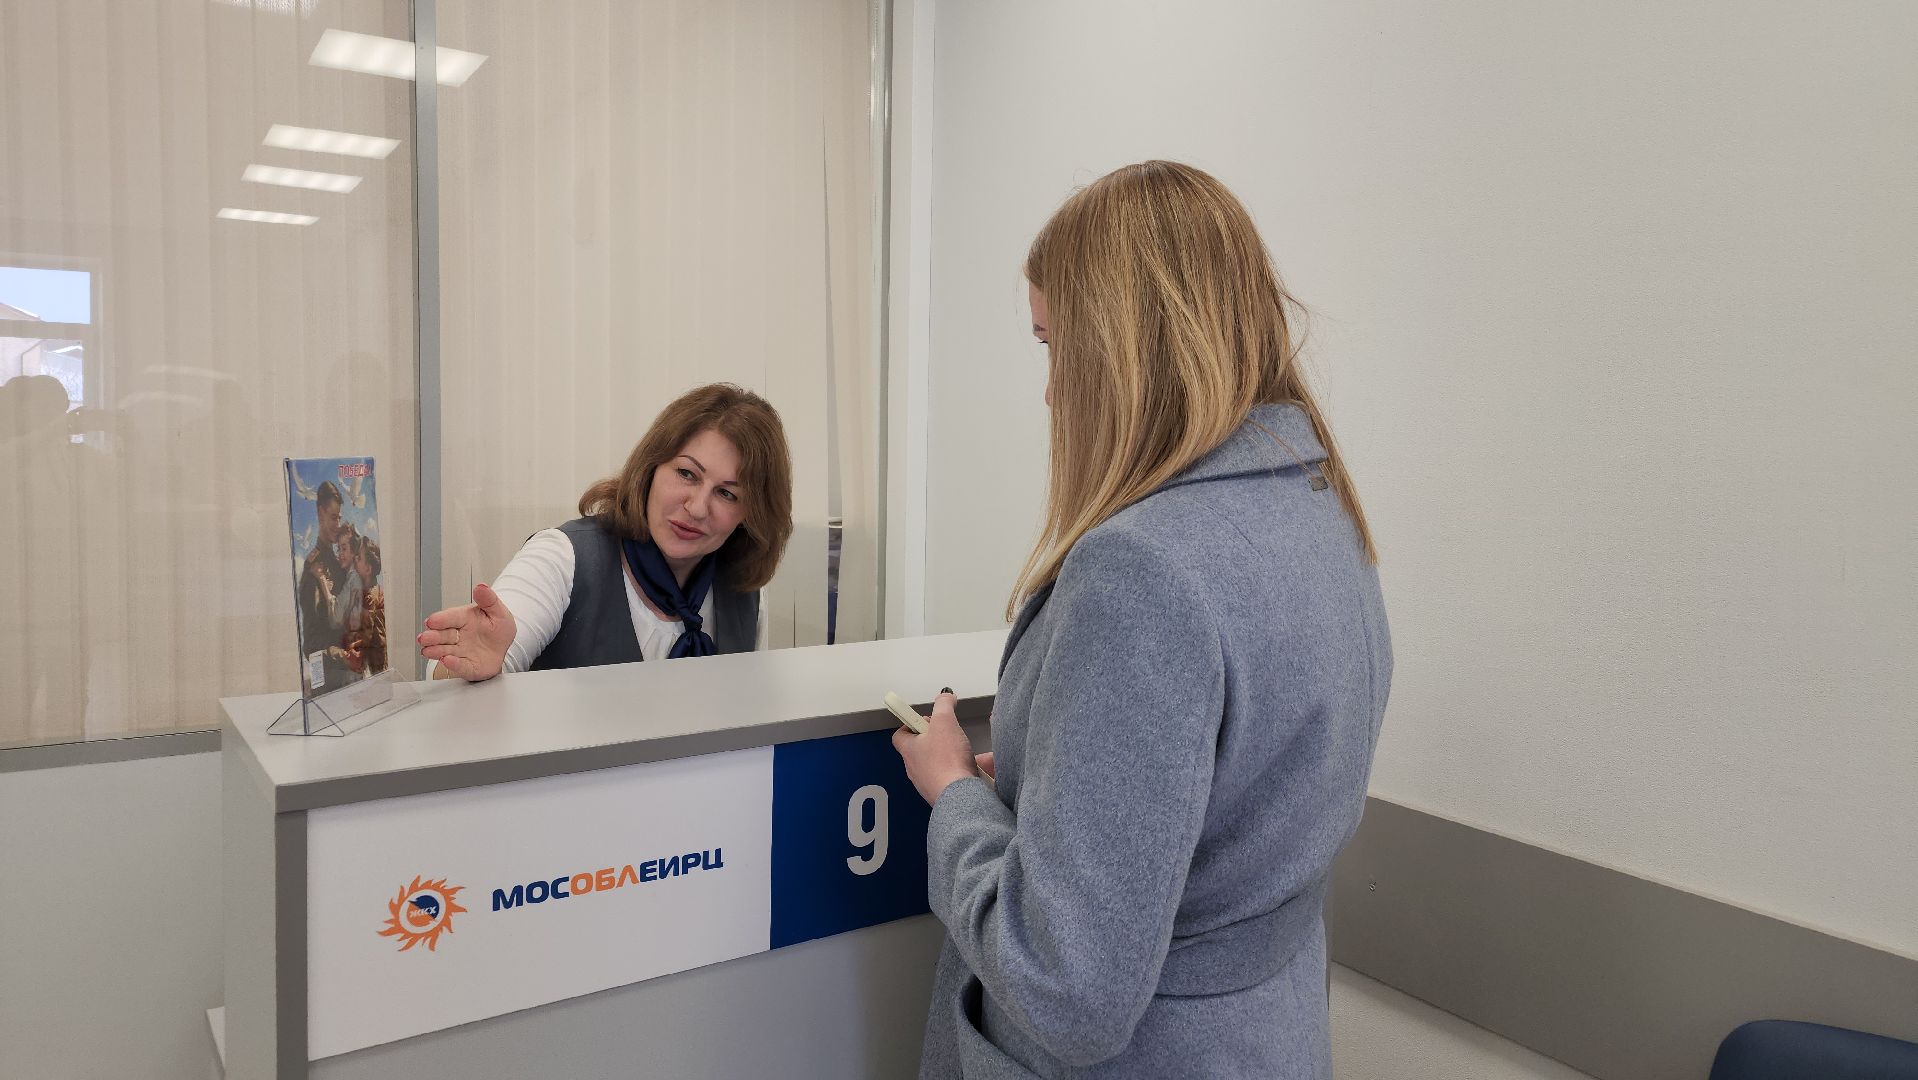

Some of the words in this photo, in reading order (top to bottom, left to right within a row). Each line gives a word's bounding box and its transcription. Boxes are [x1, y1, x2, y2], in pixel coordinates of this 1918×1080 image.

[847, 784, 889, 876] 9
[410, 906, 436, 918] ЖКХ
[492, 848, 724, 912] МОСОБЛЕИРЦ
